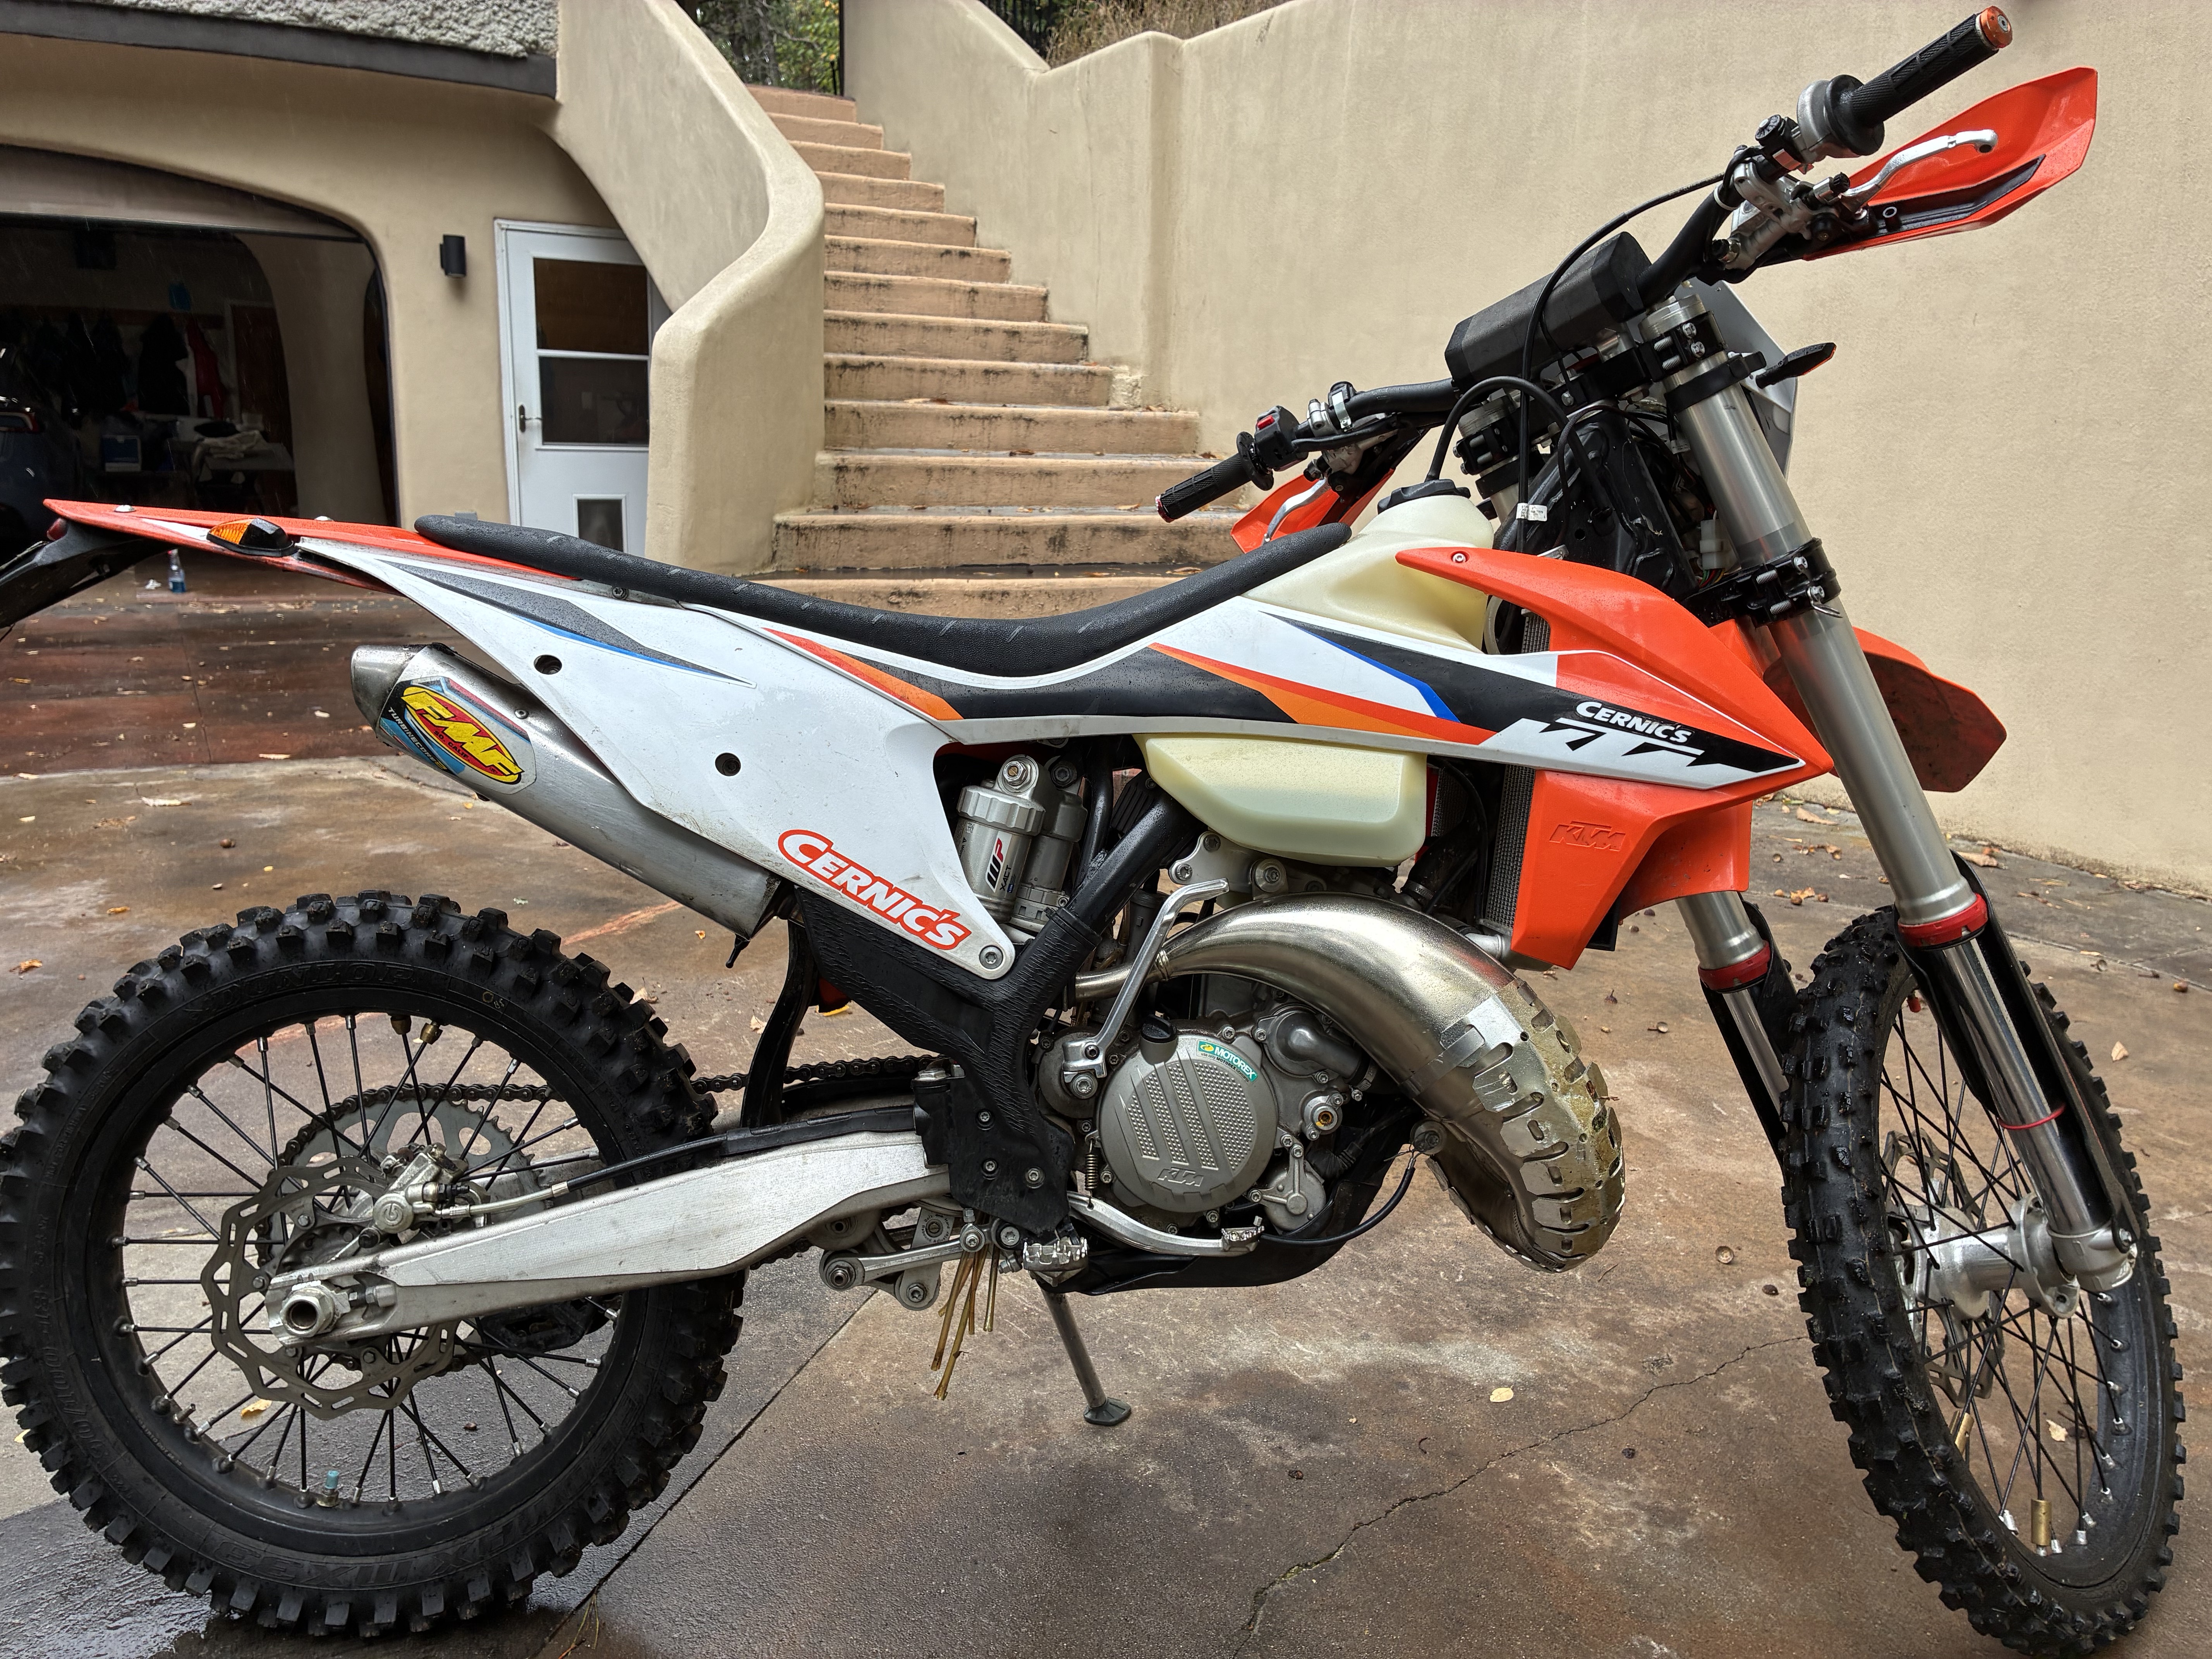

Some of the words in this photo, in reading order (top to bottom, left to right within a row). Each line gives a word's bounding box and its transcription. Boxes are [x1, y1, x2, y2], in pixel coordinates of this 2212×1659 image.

[401, 691, 524, 775] FMF
[1576, 701, 1692, 743] CERNIC'S
[1549, 821, 1626, 852] KTM
[988, 837, 1003, 889] WP
[999, 864, 1012, 891] XACT
[778, 830, 971, 950] CERNIC'S
[1214, 1046, 1255, 1079] MOTOREX
[1216, 1057, 1236, 1070] MOTOREX
[1158, 1167, 1204, 1187] KTM
